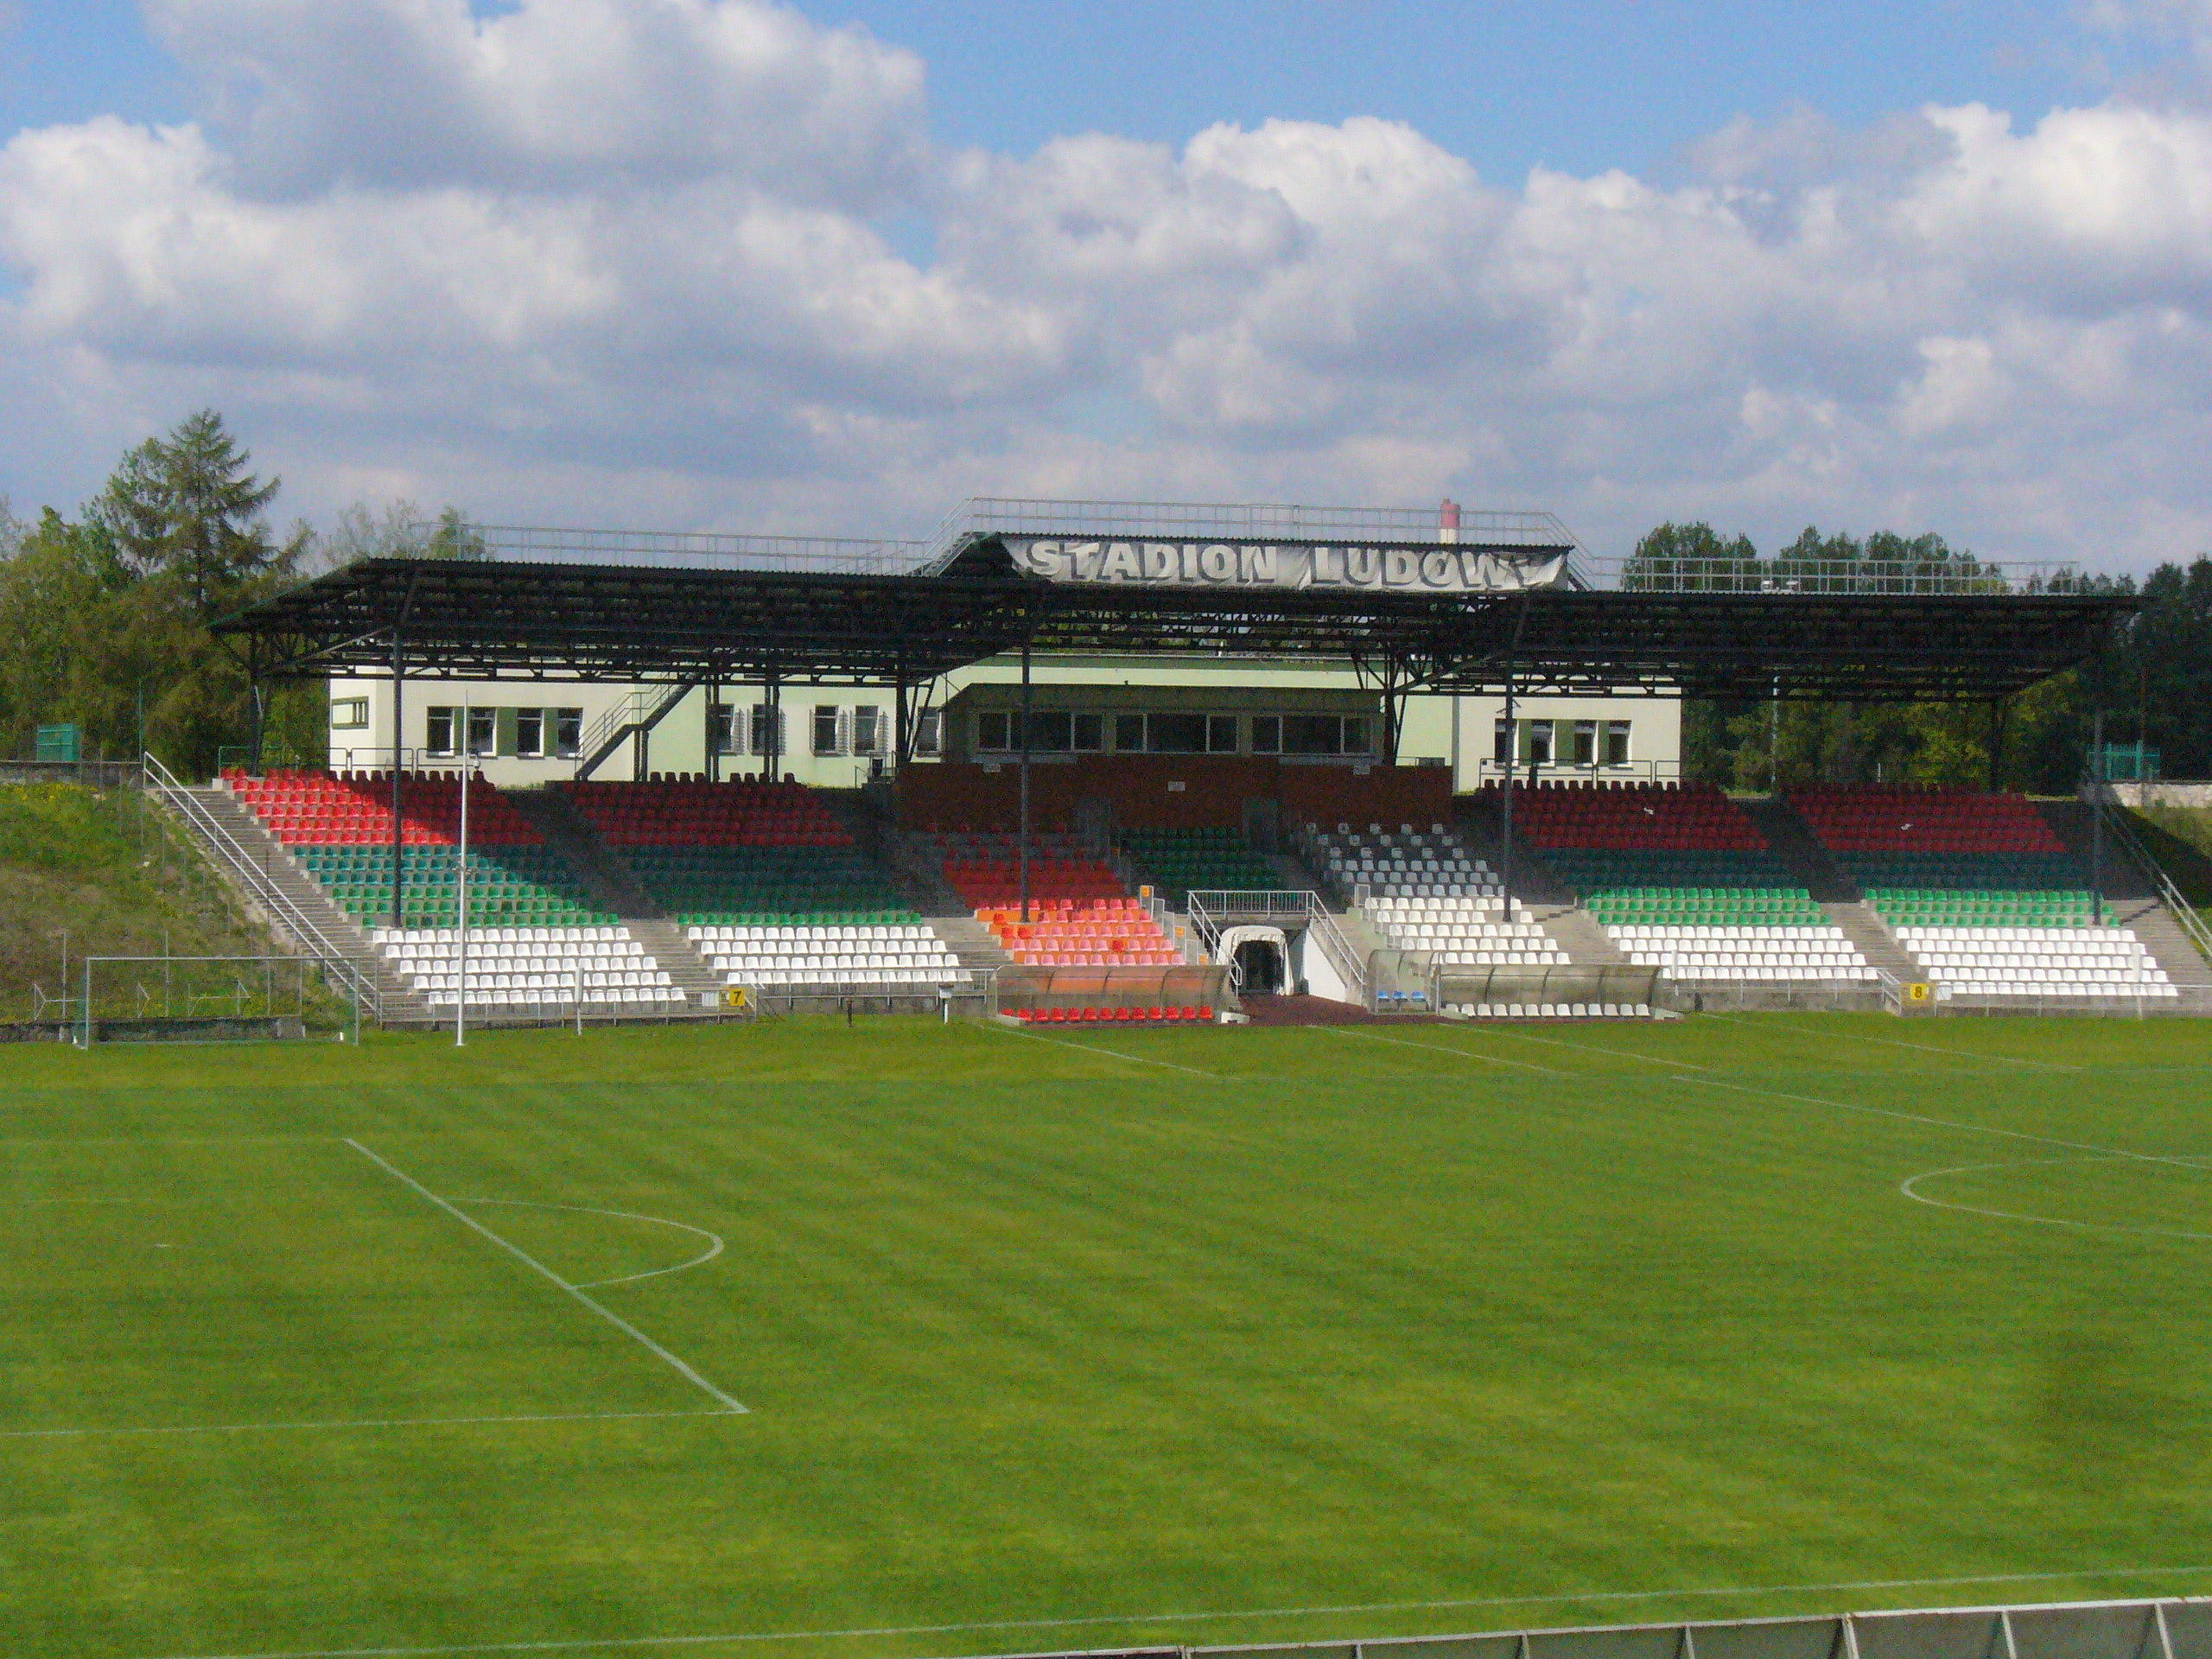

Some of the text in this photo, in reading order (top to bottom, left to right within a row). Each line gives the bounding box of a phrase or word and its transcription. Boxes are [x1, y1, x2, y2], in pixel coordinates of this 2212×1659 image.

[1027, 541, 1278, 583] STADION
[733, 990, 741, 1003] 7
[1914, 986, 1923, 998] 8
